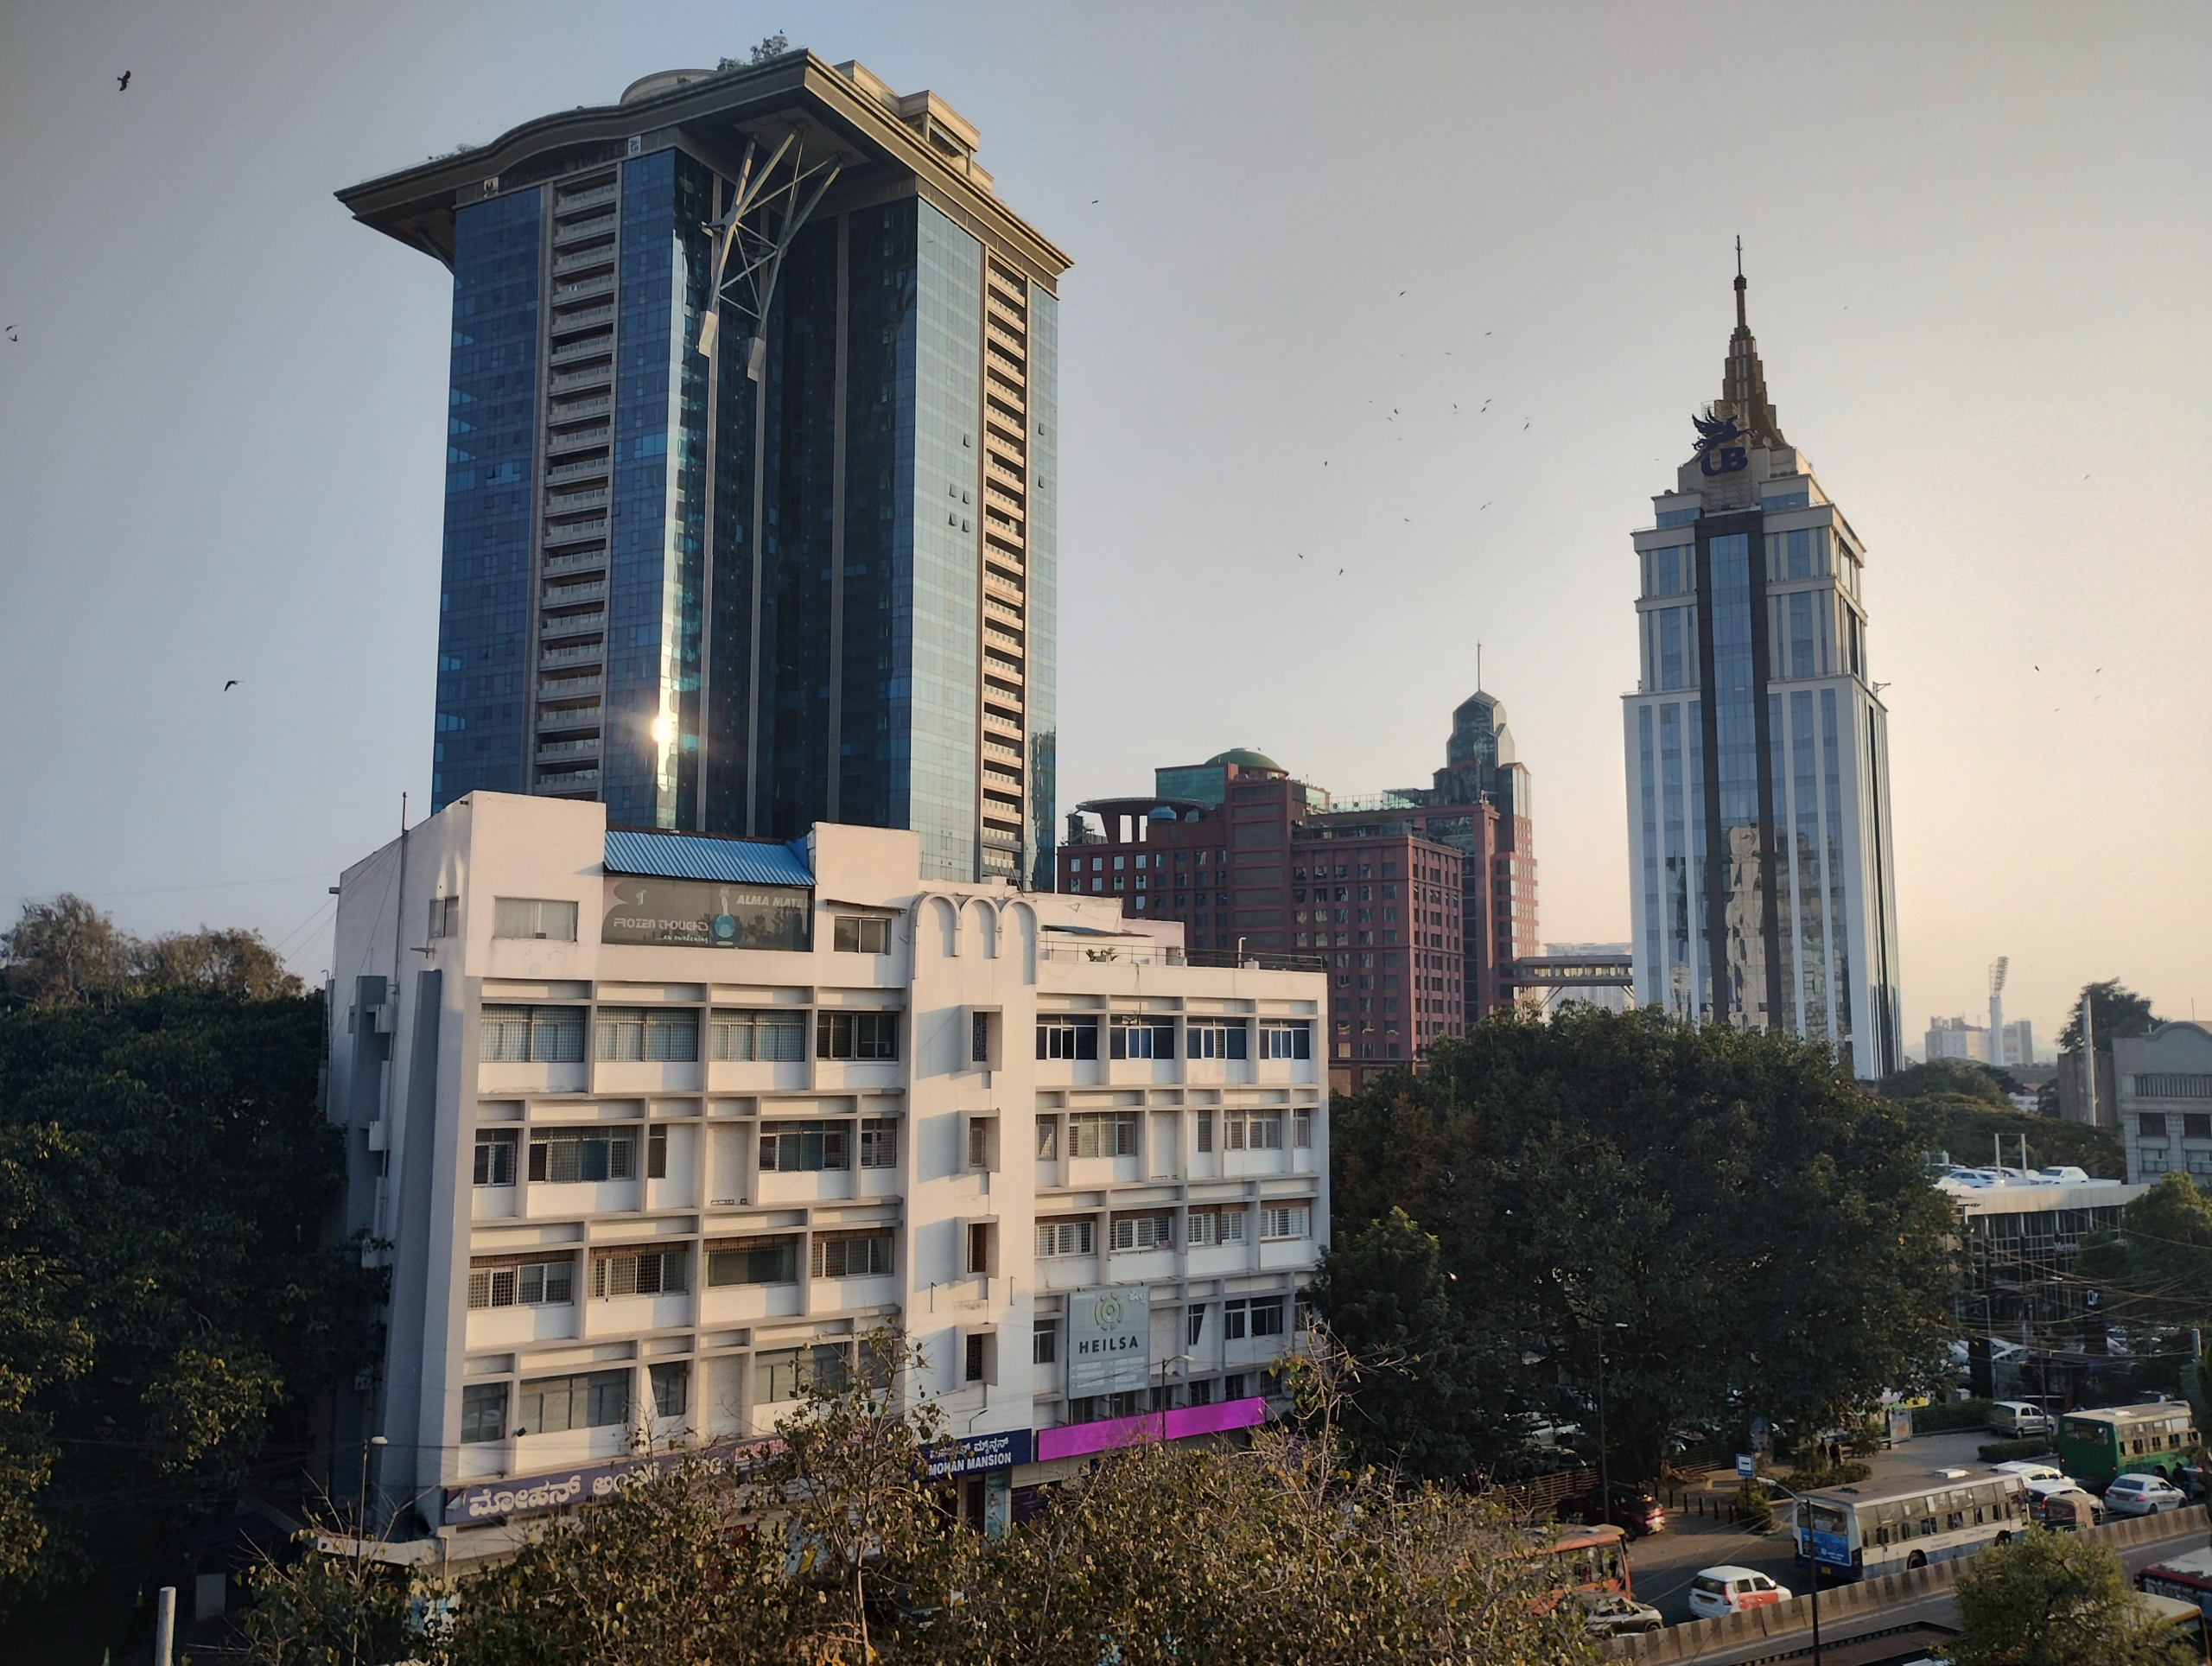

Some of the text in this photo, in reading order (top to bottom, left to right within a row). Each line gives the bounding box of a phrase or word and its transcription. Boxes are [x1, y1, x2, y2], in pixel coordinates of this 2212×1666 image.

[1701, 447, 1748, 476] UB
[736, 894, 769, 906] ALMA
[613, 917, 709, 932] FROZEN THOUGHTS
[673, 932, 709, 944] awakening
[1079, 1335, 1139, 1354] HEILSA
[928, 1452, 1011, 1476] MOHAN MANSION
[468, 1474, 581, 1517] ಮೋಹನ್
